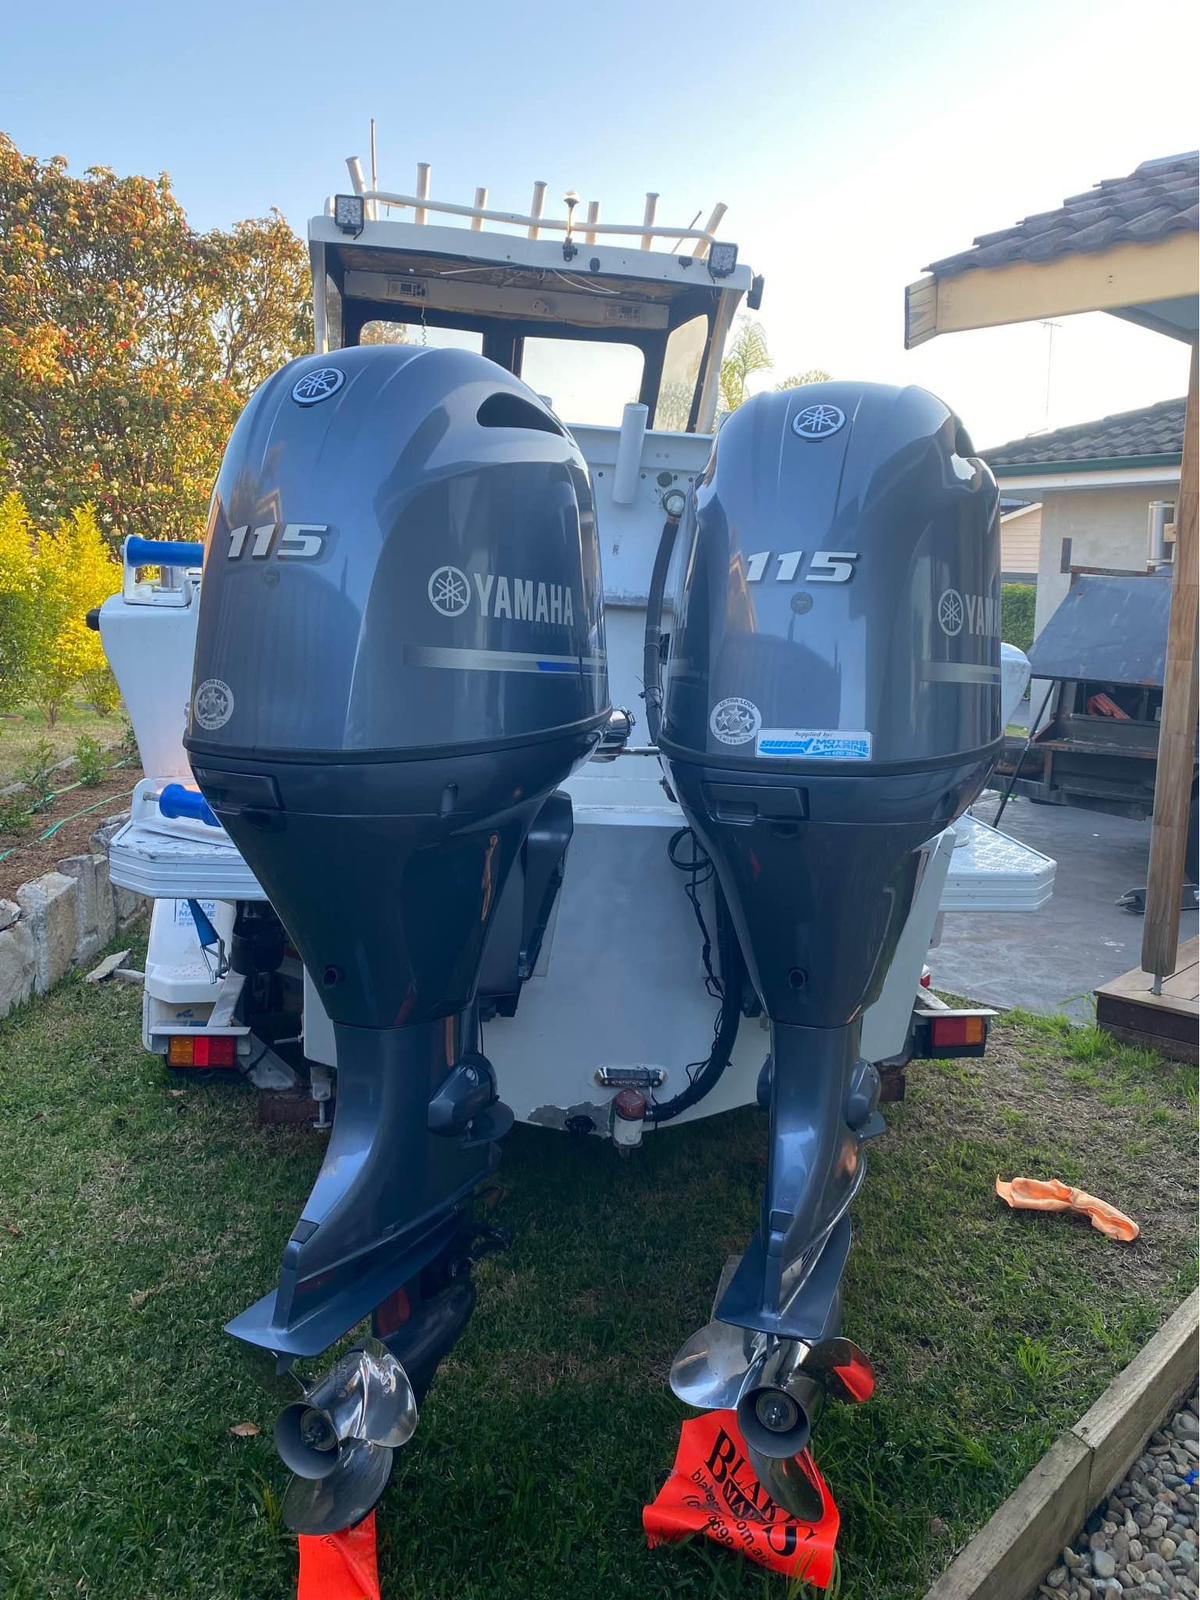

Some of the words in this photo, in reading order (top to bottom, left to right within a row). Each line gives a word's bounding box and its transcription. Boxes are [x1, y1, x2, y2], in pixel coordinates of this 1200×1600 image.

[227, 523, 329, 559] 115
[745, 551, 859, 583] 115
[474, 572, 575, 626] YAMAHA
[740, 699, 755, 710] LOW
[816, 739, 867, 747] MOTORS
[823, 744, 869, 754] MARINE
